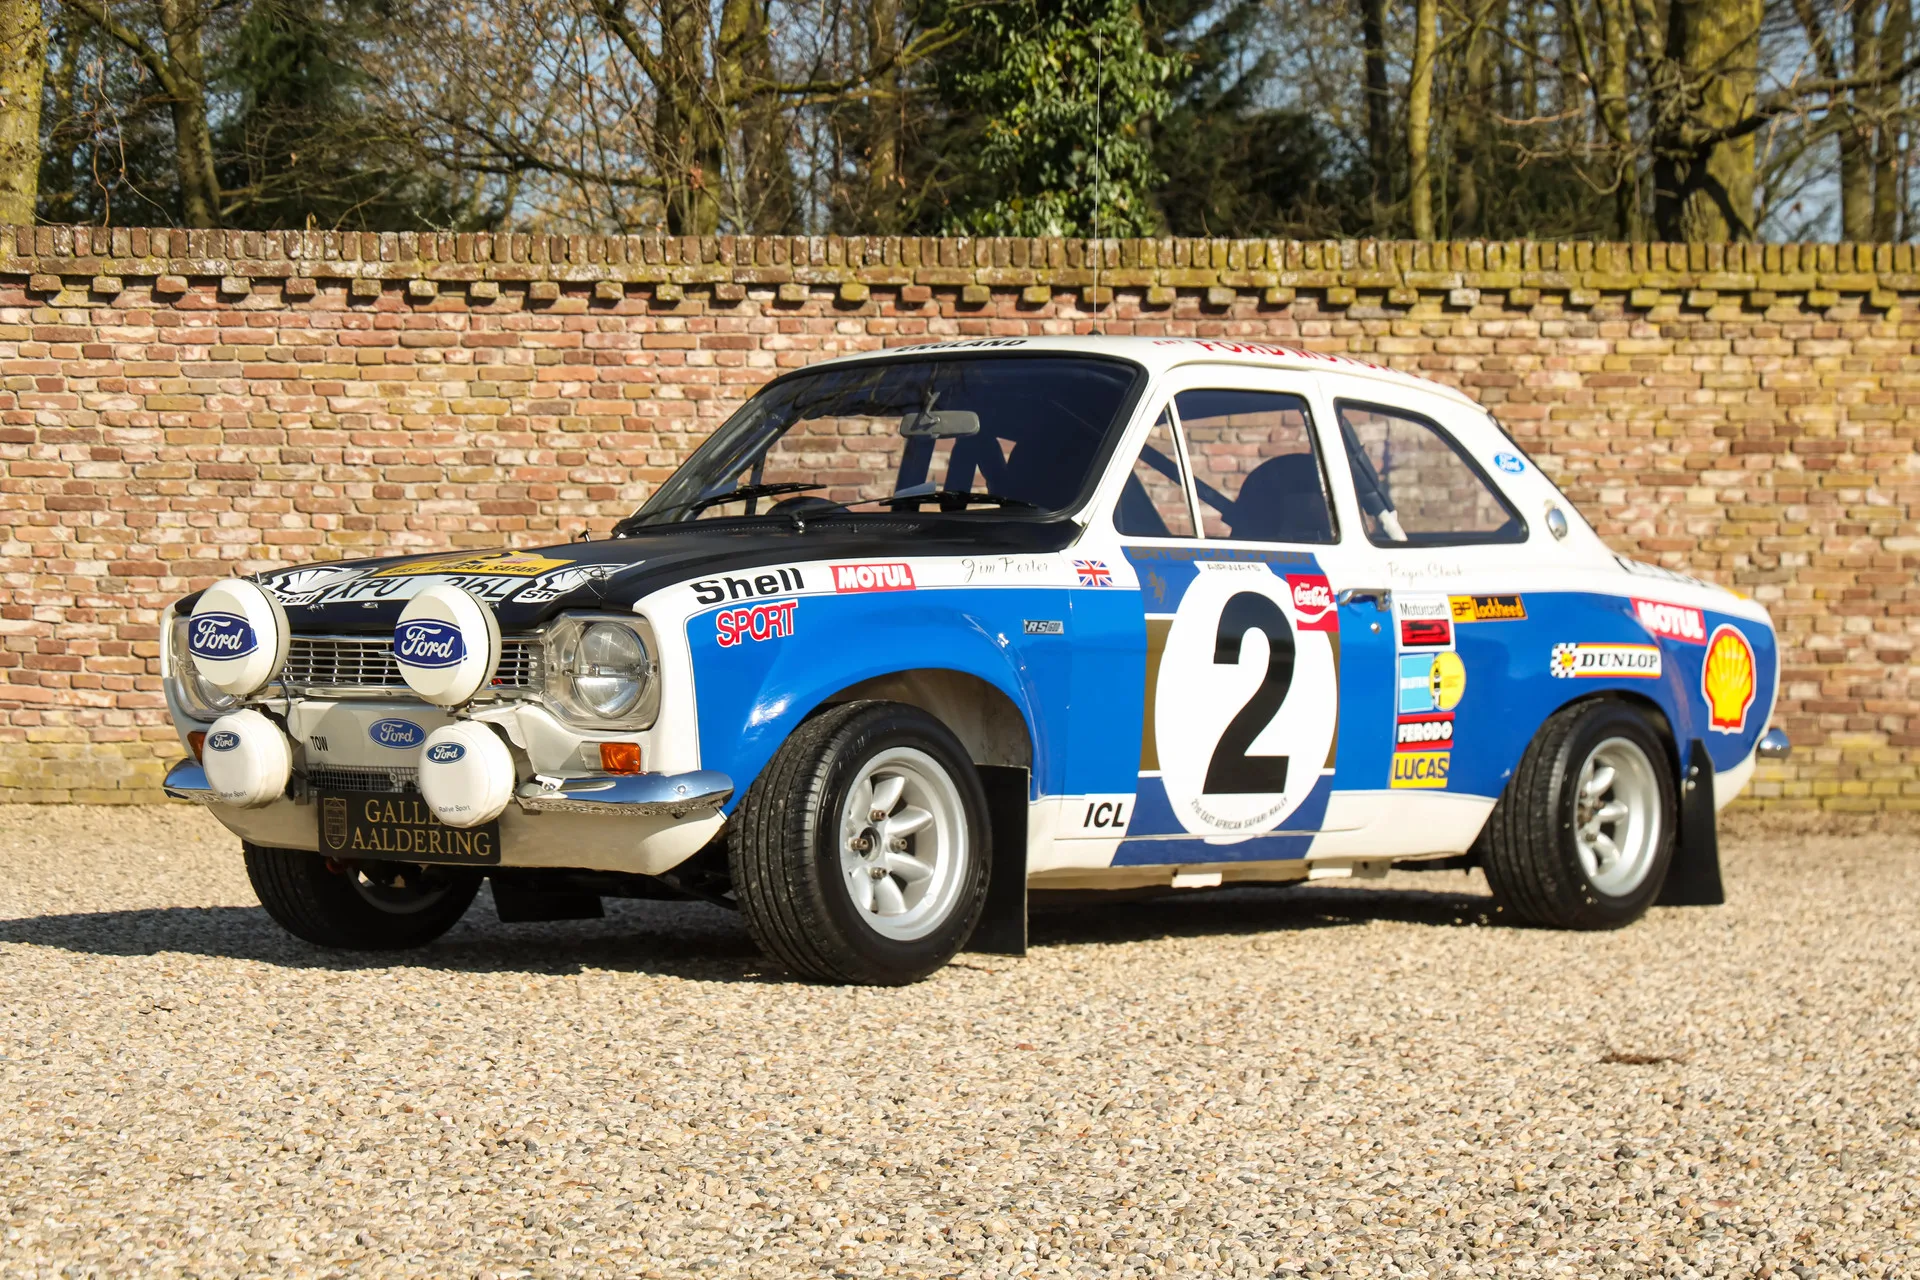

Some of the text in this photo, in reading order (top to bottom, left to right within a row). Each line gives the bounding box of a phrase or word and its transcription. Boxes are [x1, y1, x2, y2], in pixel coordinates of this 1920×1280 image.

[895, 339, 1028, 352] ENGLAND
[1192, 337, 1286, 356] FORD
[488, 564, 543, 574] SAFARI
[838, 565, 912, 589] MOTUL
[1207, 562, 1261, 573] AIRWAYS
[327, 577, 414, 599] XPU
[690, 567, 804, 605] Shell
[270, 591, 316, 604] hell
[1474, 596, 1524, 618] Lockheed
[1400, 602, 1447, 617] Motorcraft
[1637, 600, 1704, 640] MOTUL
[194, 619, 244, 650] Ford
[717, 602, 797, 647] SPORT
[401, 626, 455, 658] Ford
[1580, 653, 1658, 668] DUNLOP
[1202, 590, 1296, 796] 2
[214, 734, 234, 747] Ford
[380, 721, 415, 744] Ford
[1398, 721, 1453, 743] FERODO
[310, 736, 328, 751] TOW
[433, 745, 458, 760] Ford
[1394, 757, 1449, 780] LUCAS
[365, 799, 442, 826] GALLE
[455, 804, 471, 812] Sport
[1083, 802, 1125, 828] ICL
[351, 827, 492, 856] AALDERING
